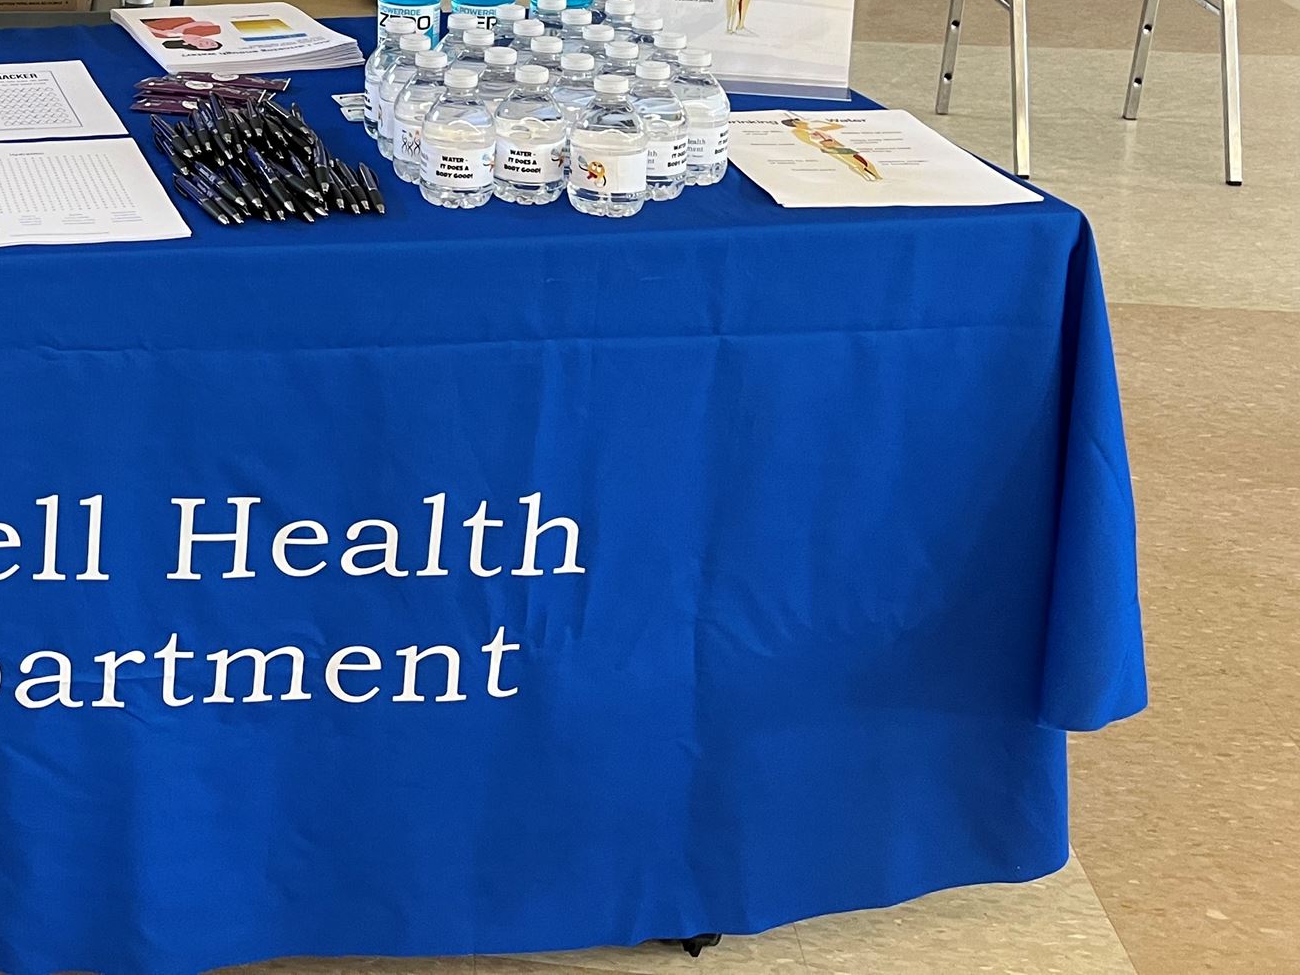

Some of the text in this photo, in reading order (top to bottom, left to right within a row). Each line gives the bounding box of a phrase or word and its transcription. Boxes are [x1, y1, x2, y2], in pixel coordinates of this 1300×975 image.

[504, 164, 520, 172] BODY
[436, 170, 452, 178] BODY
[166, 491, 587, 581] Health
